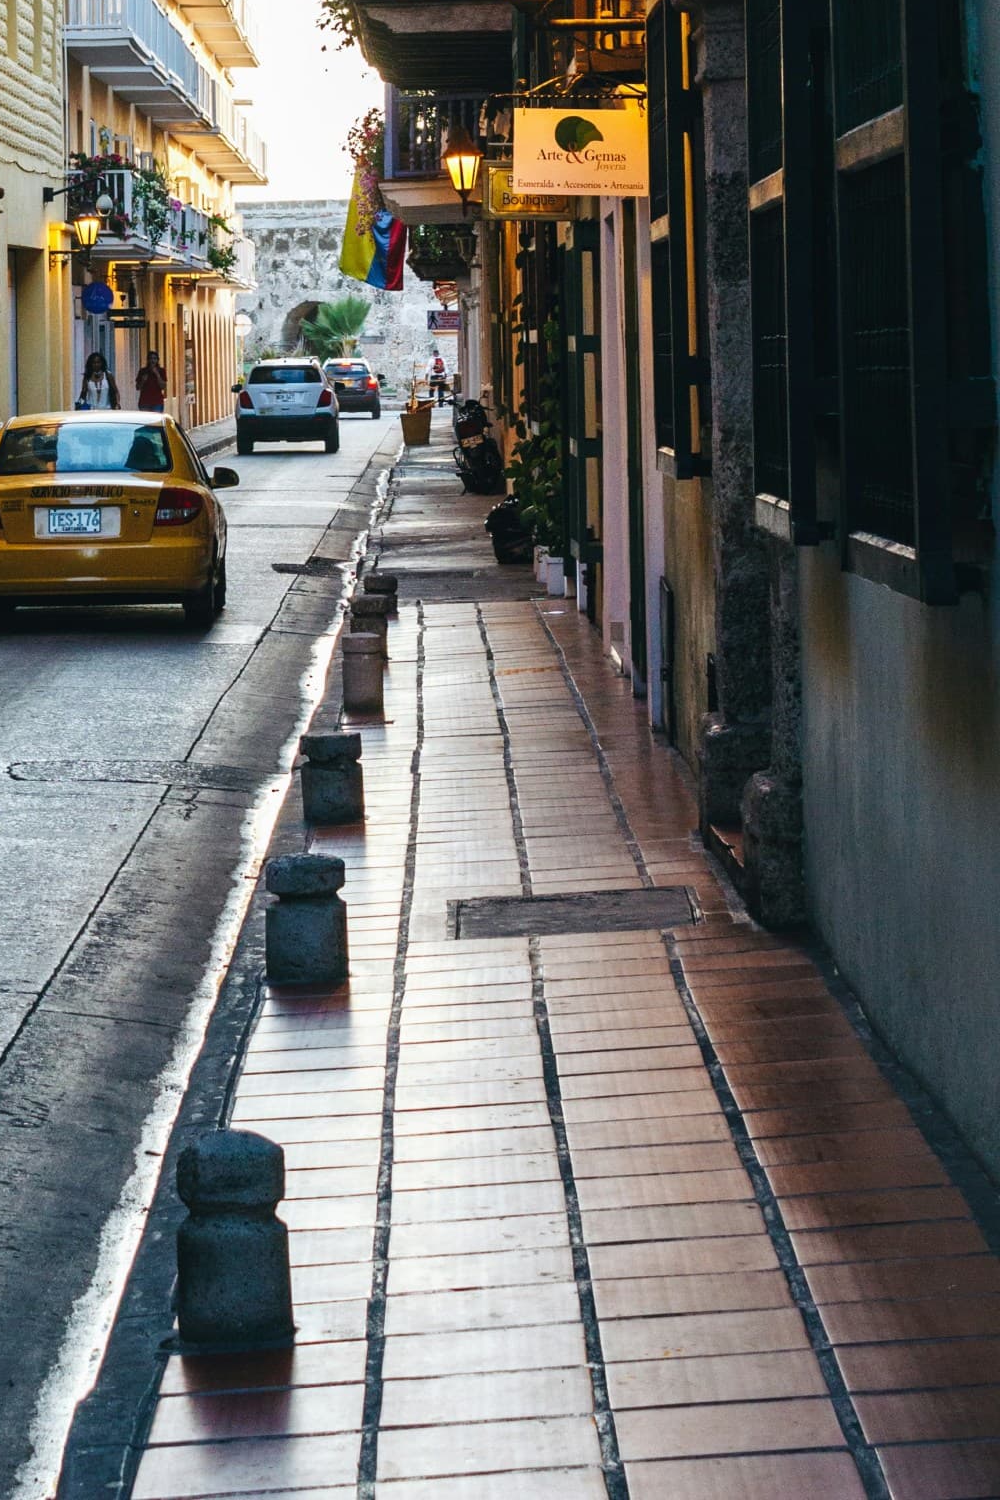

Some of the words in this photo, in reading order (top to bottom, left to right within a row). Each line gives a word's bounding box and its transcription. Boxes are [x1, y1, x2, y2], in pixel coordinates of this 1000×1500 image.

[537, 149, 563, 161] Arte
[565, 140, 584, 164] &
[584, 149, 626, 162] Gemas
[518, 179, 554, 188] Esmeralda
[563, 180, 601, 189] Accesorios
[30, 486, 71, 498] SERVICIO
